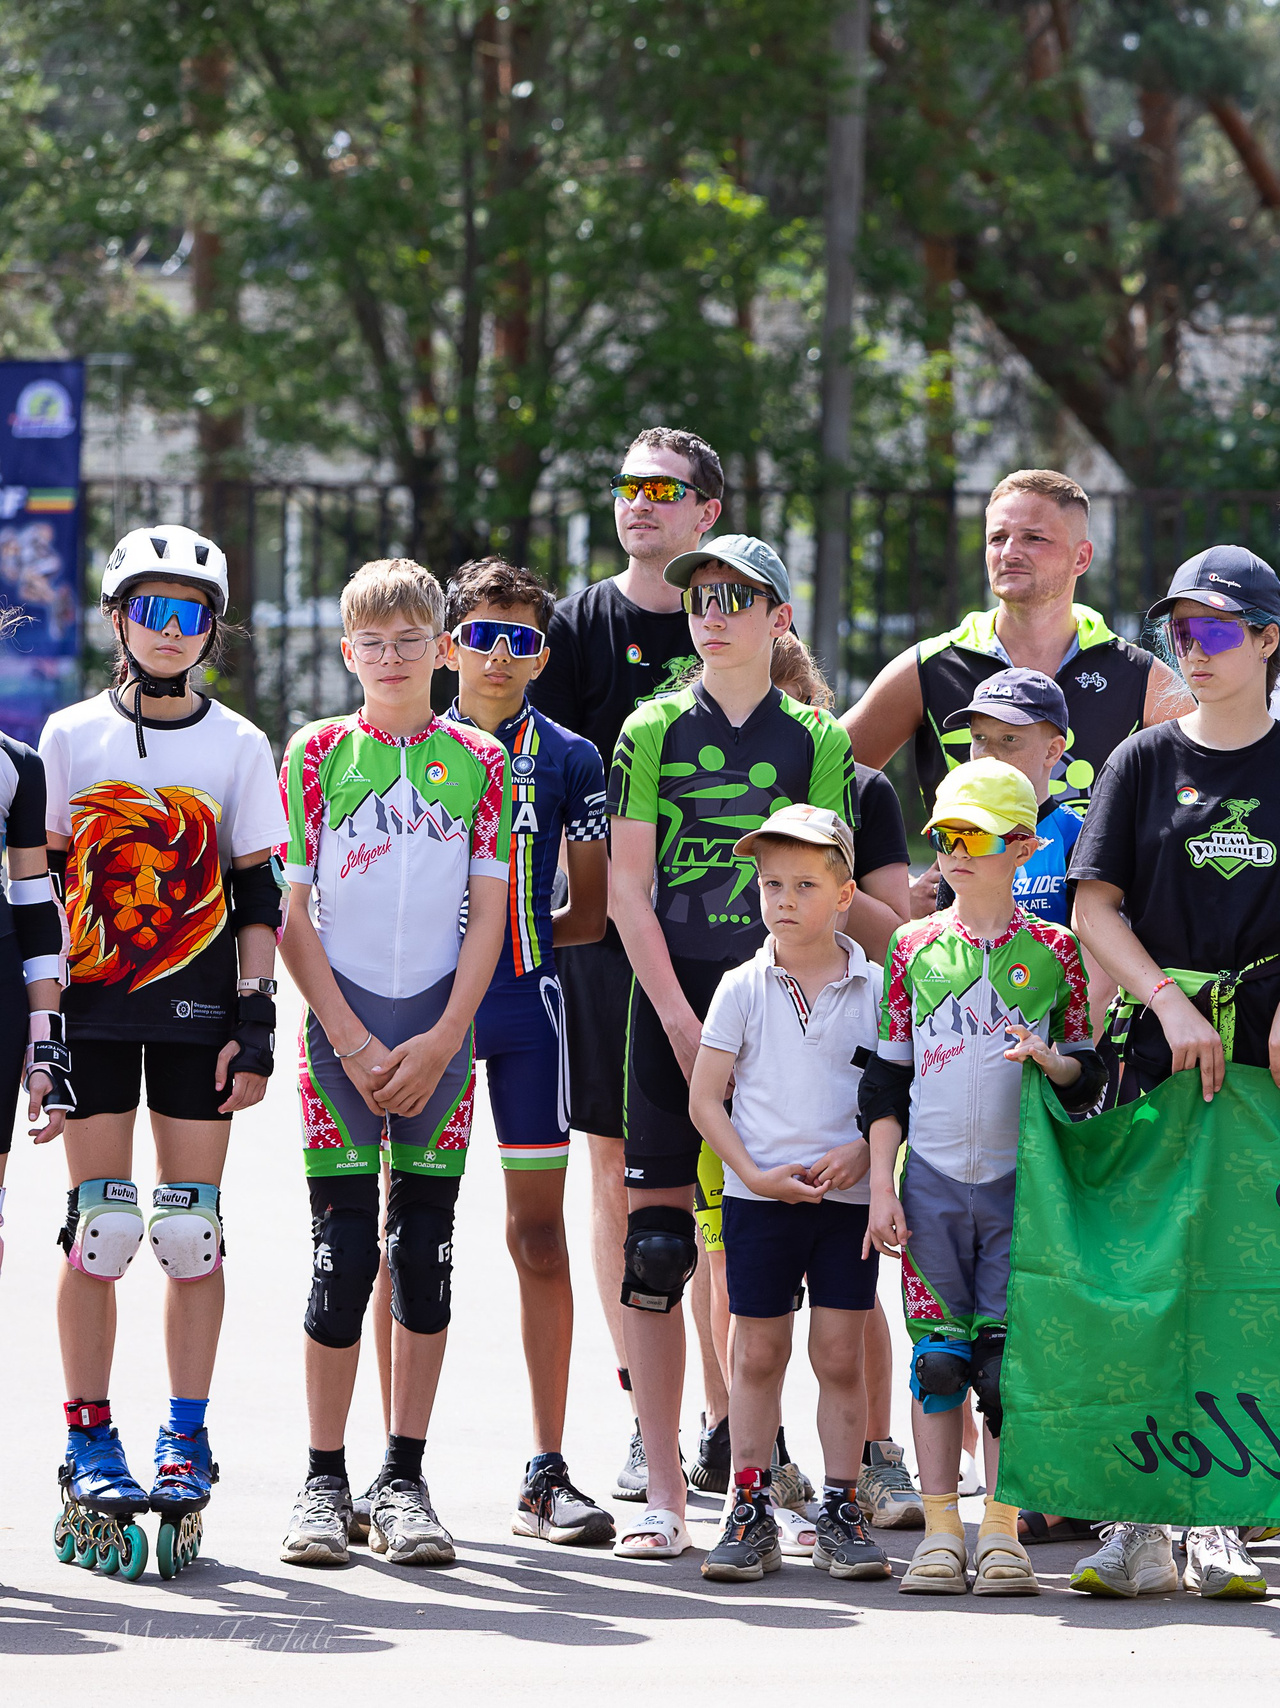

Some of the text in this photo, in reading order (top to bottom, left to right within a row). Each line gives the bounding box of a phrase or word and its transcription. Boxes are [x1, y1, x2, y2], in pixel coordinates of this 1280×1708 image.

[107, 547, 127, 570] 09
[1208, 573, 1242, 588] Champion
[978, 684, 1013, 698] FILA
[1216, 836, 1244, 845] TEAM
[1012, 875, 1065, 896] SLIDE
[1018, 898, 1051, 910] SKATE.
[921, 1038, 966, 1077] Soligorsk
[336, 1161, 368, 1169] ROADSTAR
[413, 1161, 447, 1169] ROADSTAR
